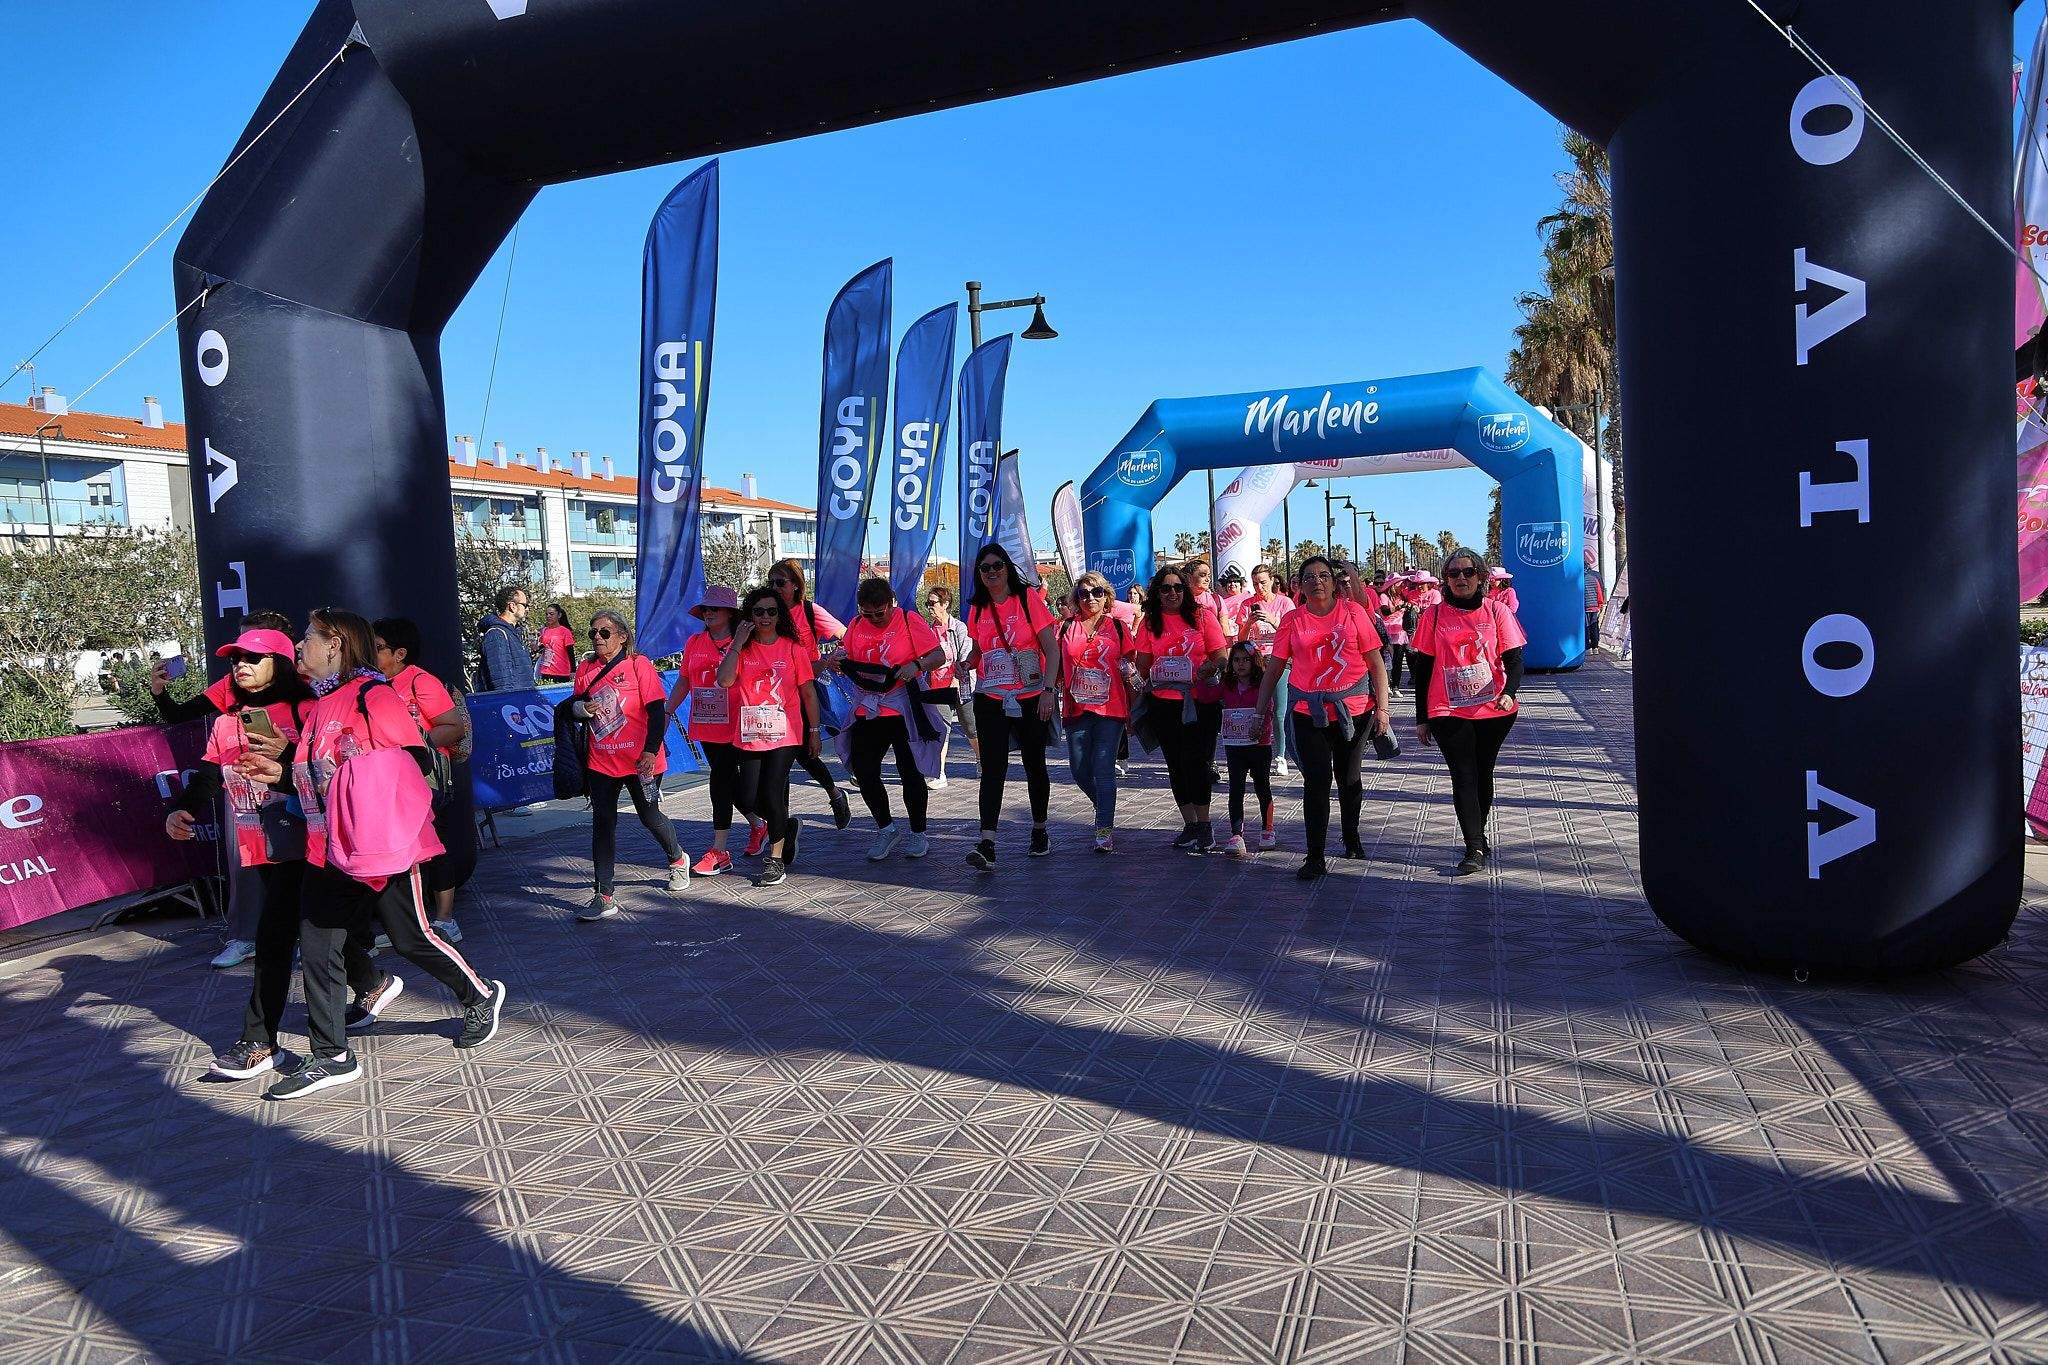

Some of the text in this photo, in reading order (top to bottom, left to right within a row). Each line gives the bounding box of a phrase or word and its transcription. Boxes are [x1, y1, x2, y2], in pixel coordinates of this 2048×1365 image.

[197, 329, 249, 618] LVO
[651, 341, 687, 504] GOYA
[830, 395, 865, 520] GOYA
[1244, 390, 1380, 453] Marlene
[1482, 421, 1527, 442] Marlene
[895, 422, 930, 531] GOYA
[969, 440, 993, 539] GOYA
[1790, 74, 1876, 879] VOLVO
[1520, 532, 1567, 555] Marlene
